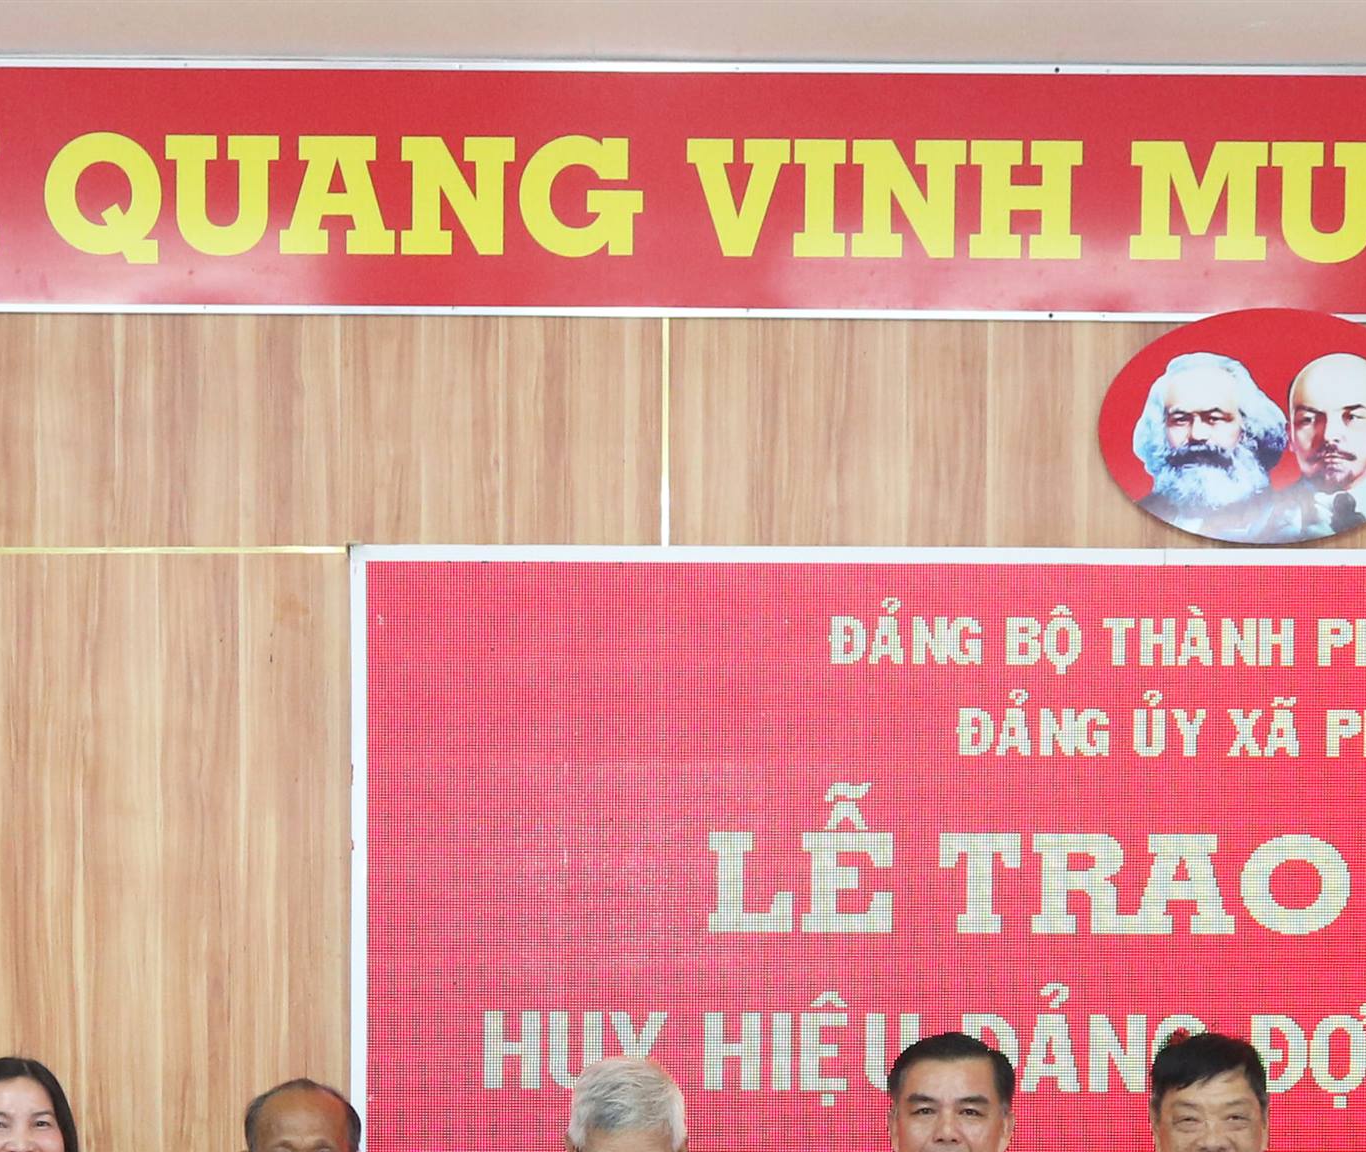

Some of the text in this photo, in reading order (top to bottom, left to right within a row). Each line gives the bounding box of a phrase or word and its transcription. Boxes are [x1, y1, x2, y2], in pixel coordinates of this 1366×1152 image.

[43, 131, 644, 262] QUANG
[686, 138, 1084, 261] VINH
[828, 597, 983, 667] ĐẢNG
[1005, 605, 1083, 677] BỘ
[1103, 606, 1295, 668] THÀNH
[955, 690, 1110, 758] ĐẢNG
[1133, 690, 1207, 758] ỦY
[1227, 697, 1301, 758] XÃ
[707, 782, 894, 936] LỄ
[938, 832, 1352, 937] TRAO
[483, 1010, 668, 1090] HUY
[703, 991, 921, 1107] HIỆU
[962, 983, 1207, 1094] ẢN
